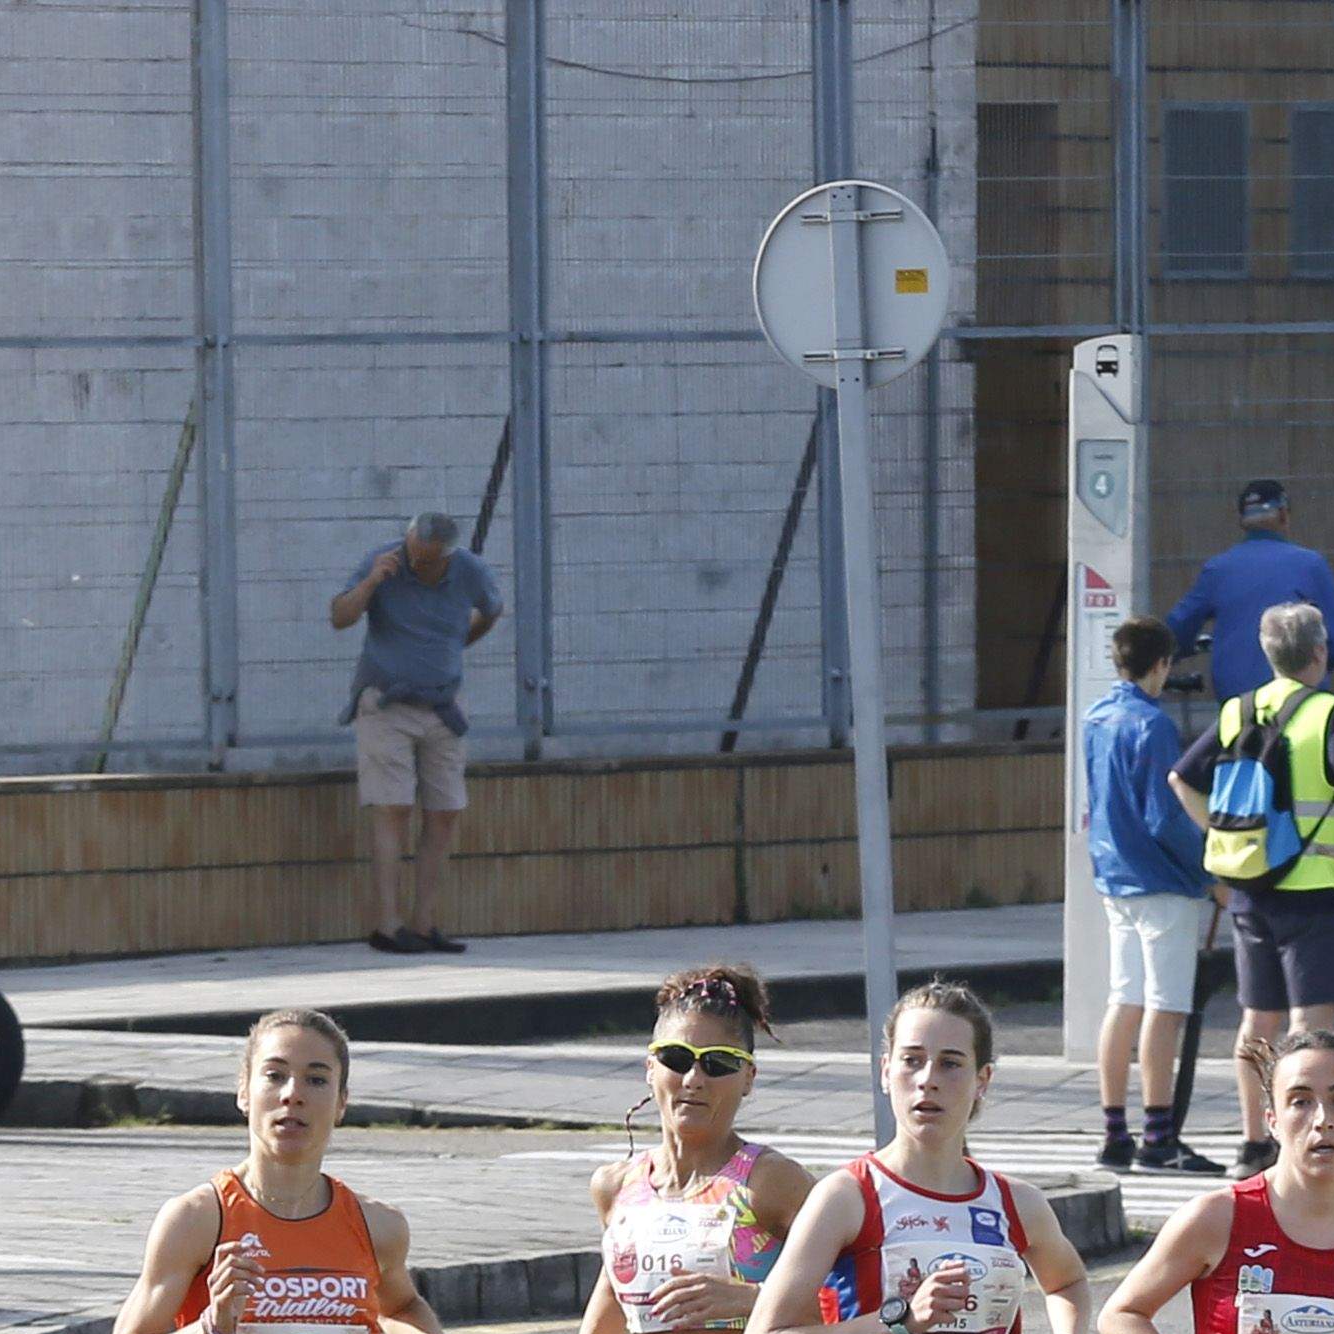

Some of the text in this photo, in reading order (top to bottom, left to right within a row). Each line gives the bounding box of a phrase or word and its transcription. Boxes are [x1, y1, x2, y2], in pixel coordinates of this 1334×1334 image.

[1095, 474, 1107, 495] 4
[642, 1254, 683, 1271] 016
[248, 1276, 367, 1298] COSPORT
